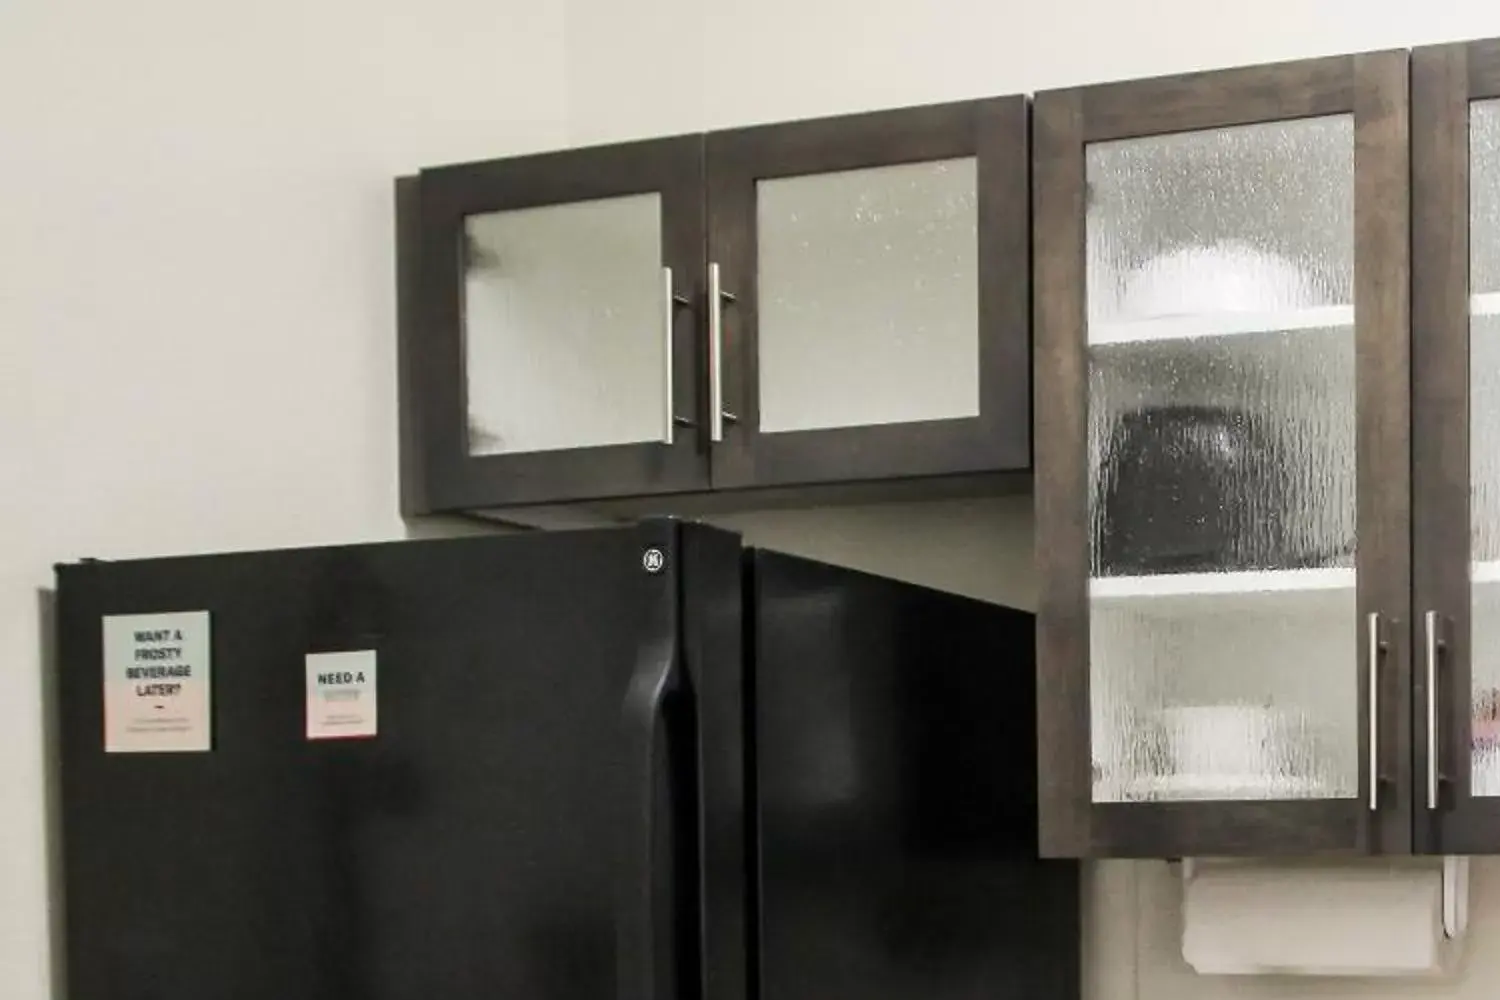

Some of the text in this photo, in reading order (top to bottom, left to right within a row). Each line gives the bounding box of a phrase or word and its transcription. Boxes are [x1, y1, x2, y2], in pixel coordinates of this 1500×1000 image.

[134, 629, 183, 642] WANT A
[134, 647, 182, 661] FROSTY
[125, 665, 192, 679] BEVERAGE
[317, 671, 366, 685] NEED A
[136, 683, 182, 697] LATER?
